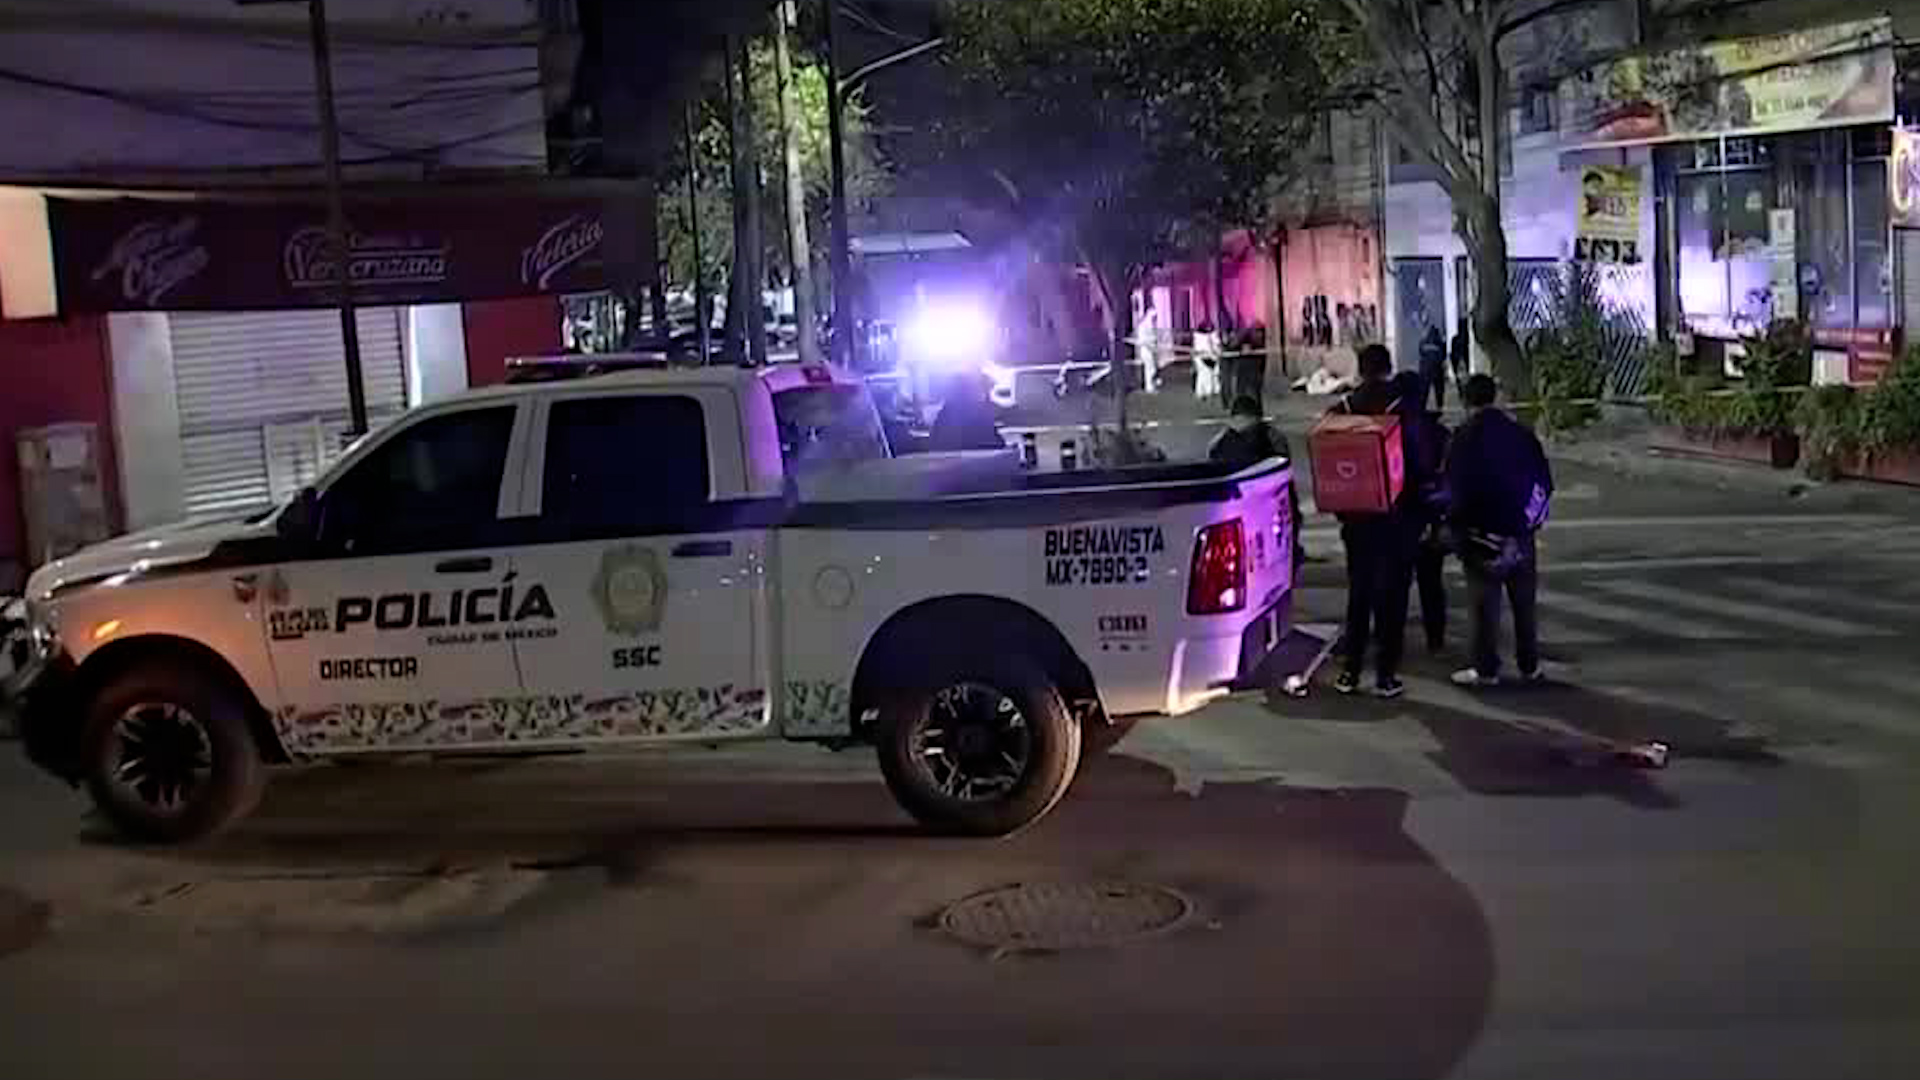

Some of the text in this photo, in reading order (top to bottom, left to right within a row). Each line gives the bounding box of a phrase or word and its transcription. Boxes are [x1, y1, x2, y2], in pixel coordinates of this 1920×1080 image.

[284, 228, 448, 282] Vercruzana
[1045, 527, 1164, 556] BUENAVISTA
[335, 573, 555, 632] POLICÍA
[319, 657, 418, 681] DIRECTOR
[612, 648, 661, 668] SSC
